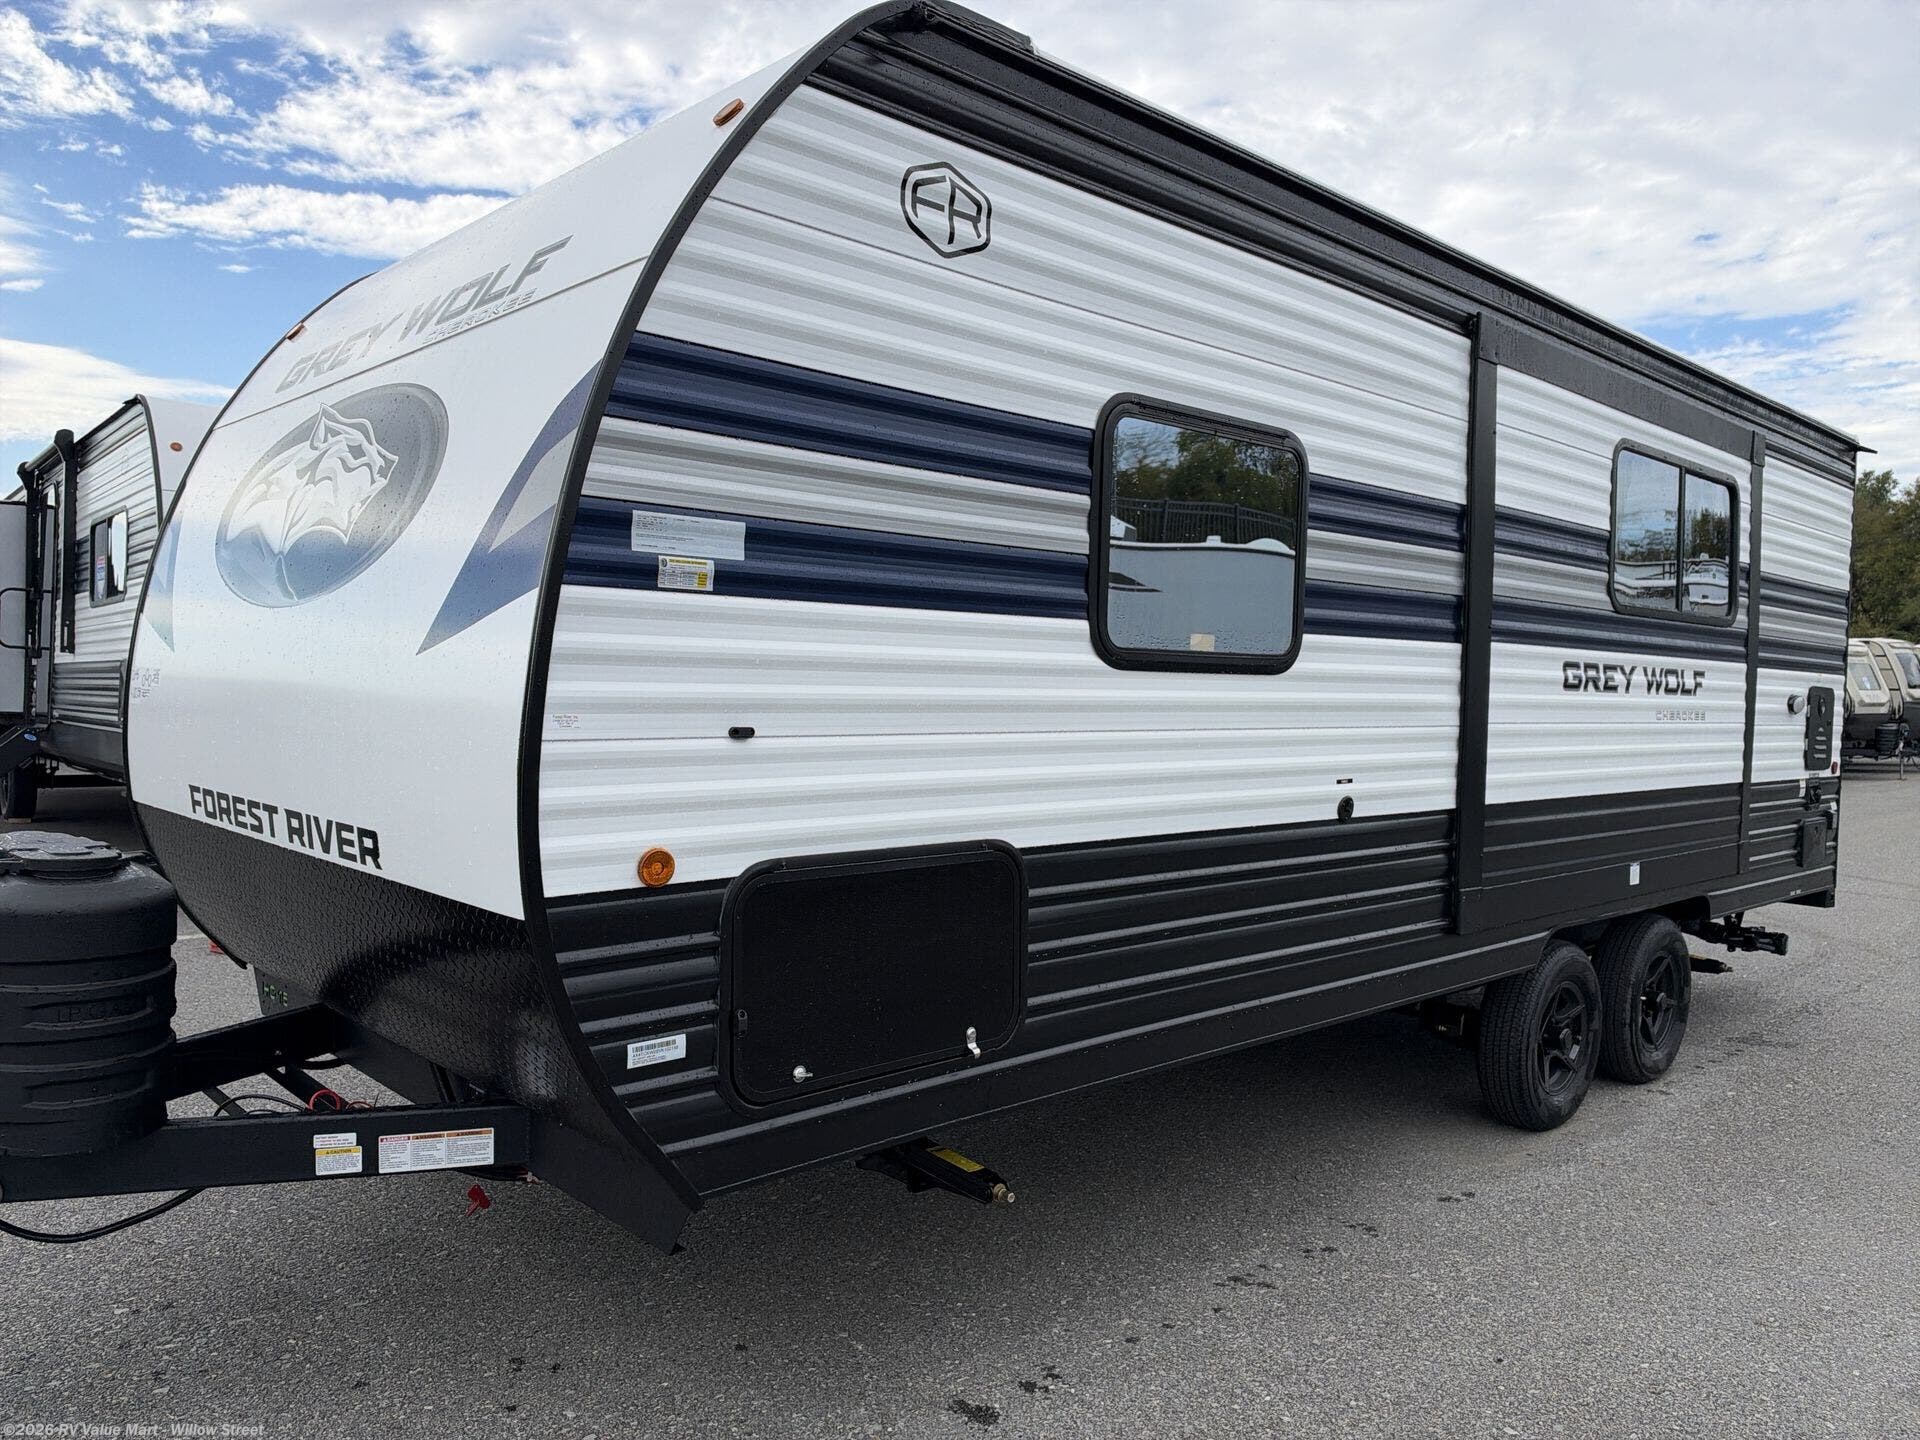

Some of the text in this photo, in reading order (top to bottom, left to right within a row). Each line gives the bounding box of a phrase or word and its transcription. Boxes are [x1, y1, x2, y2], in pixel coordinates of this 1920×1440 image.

[276, 234, 574, 393] GREY WOLF
[422, 287, 537, 345] CHEROKEE
[1562, 660, 1706, 696] GREY WOLF
[1655, 710, 1706, 721] CHEROKEE
[188, 784, 383, 870] FOREST RIVER
